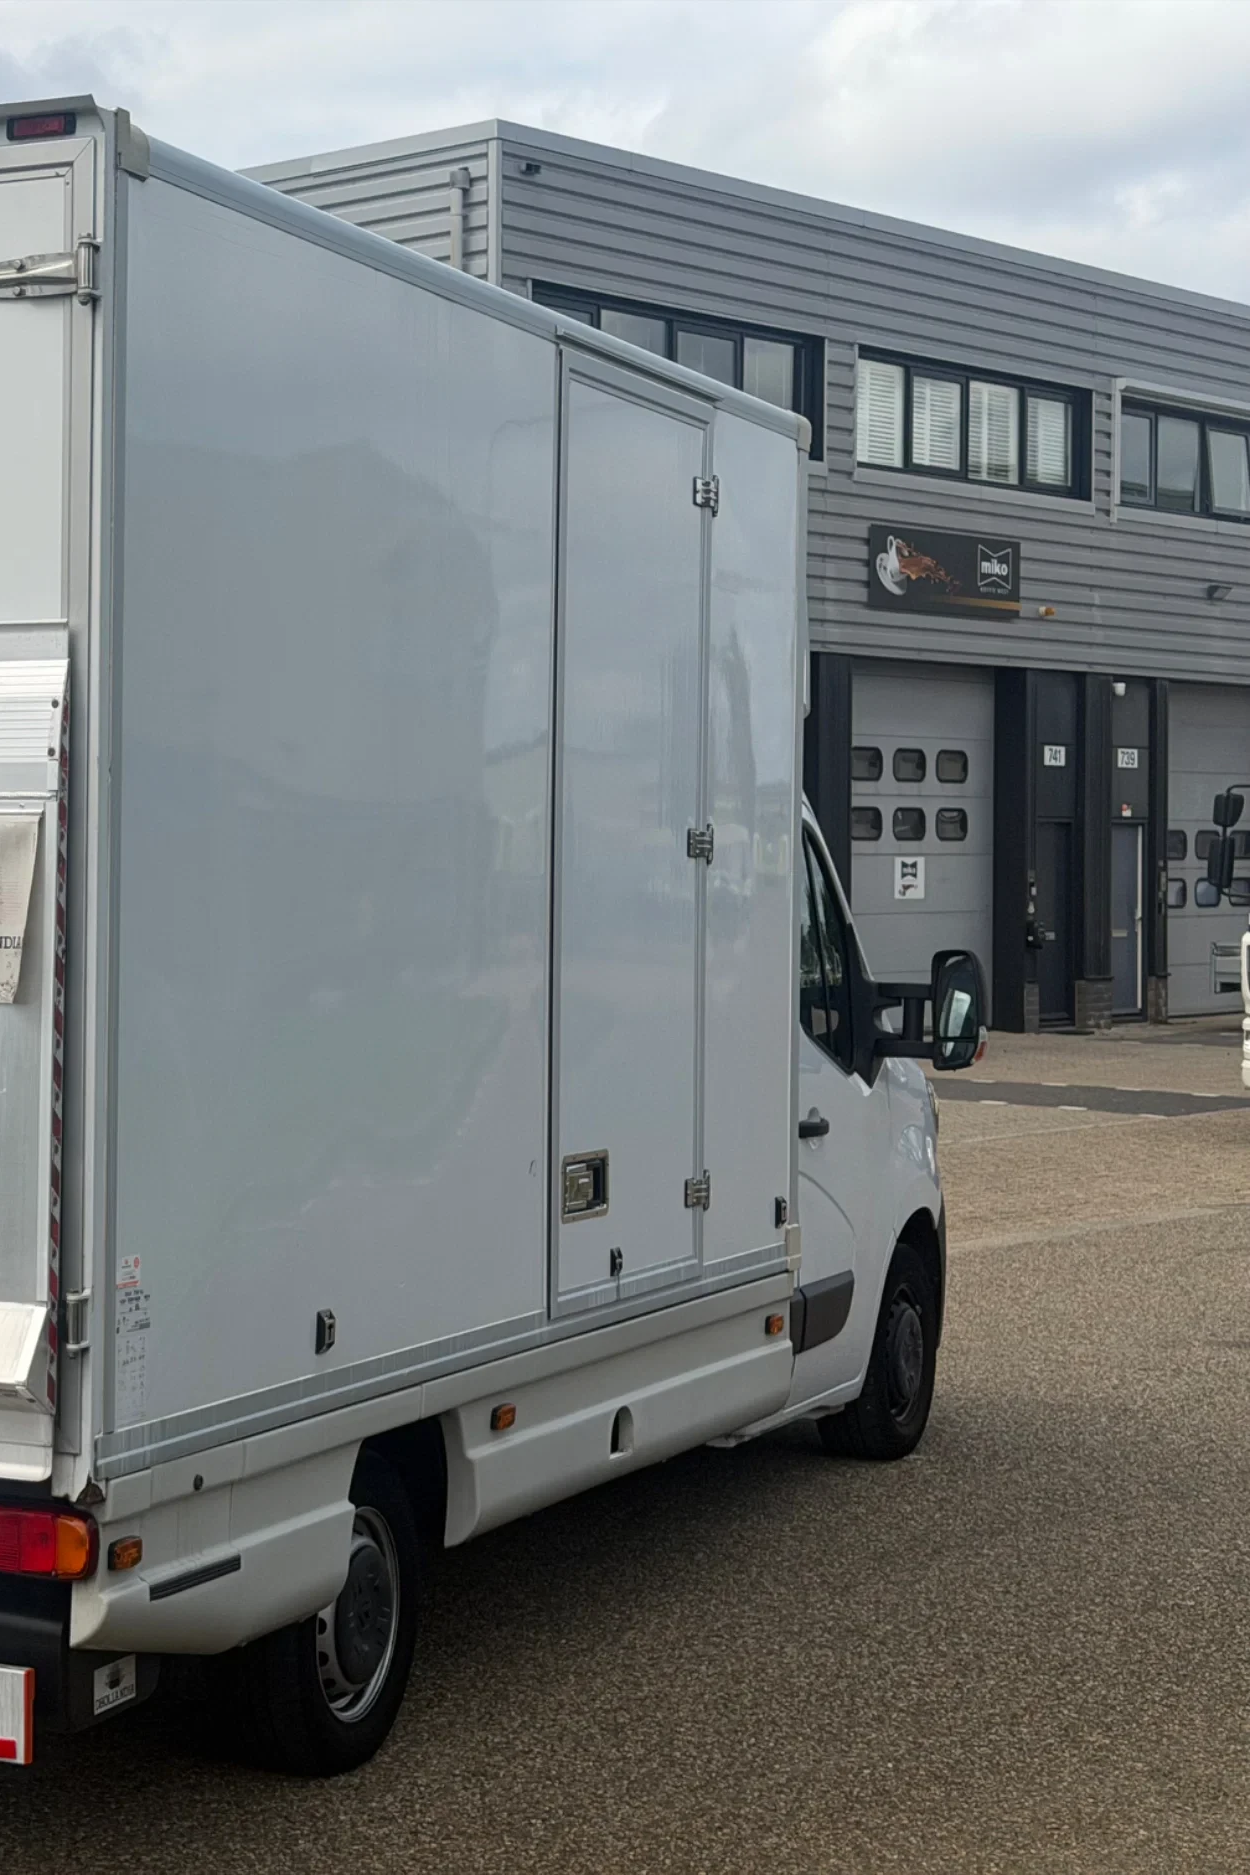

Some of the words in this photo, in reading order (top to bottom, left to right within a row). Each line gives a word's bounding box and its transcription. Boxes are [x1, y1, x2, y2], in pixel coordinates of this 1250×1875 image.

[981, 558, 1008, 576] miko
[1048, 748, 1062, 763] 741
[1120, 750, 1136, 766] 739
